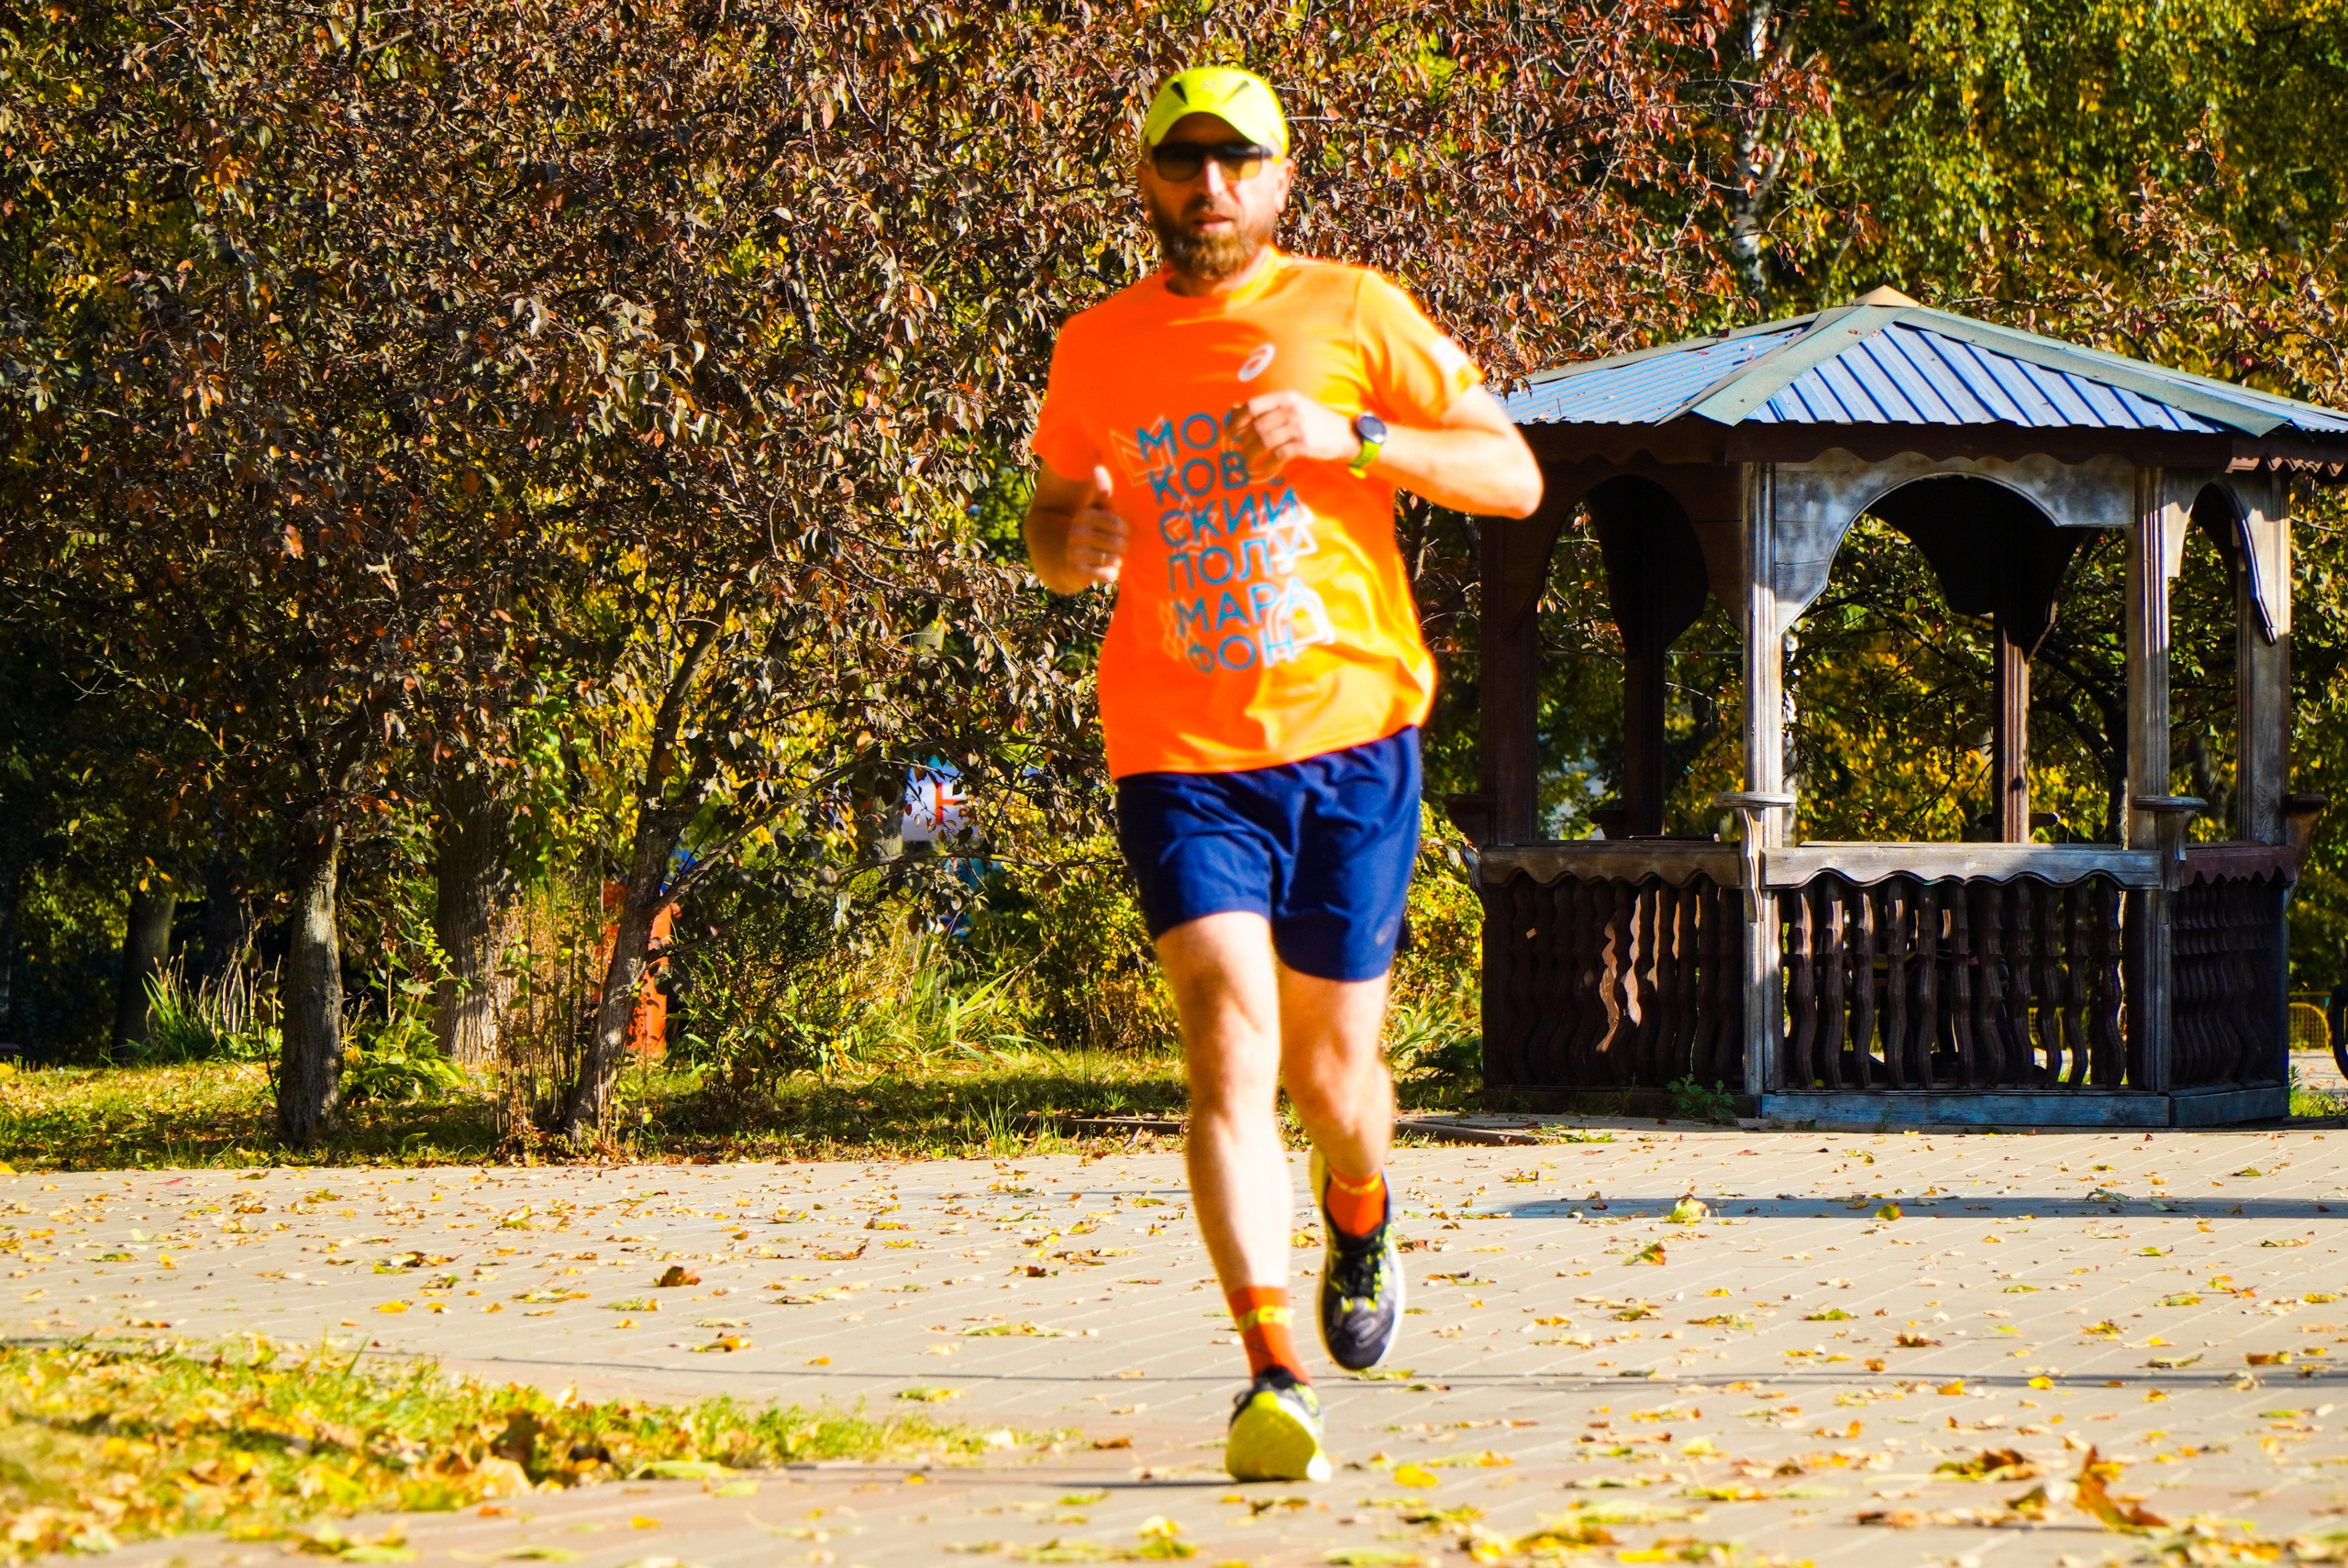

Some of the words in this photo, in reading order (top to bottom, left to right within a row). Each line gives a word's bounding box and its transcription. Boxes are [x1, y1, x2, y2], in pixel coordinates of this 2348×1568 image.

[1135, 412, 1240, 463] МО
[1148, 450, 1250, 506] КОВ
[1174, 576, 1309, 637] МАРА
